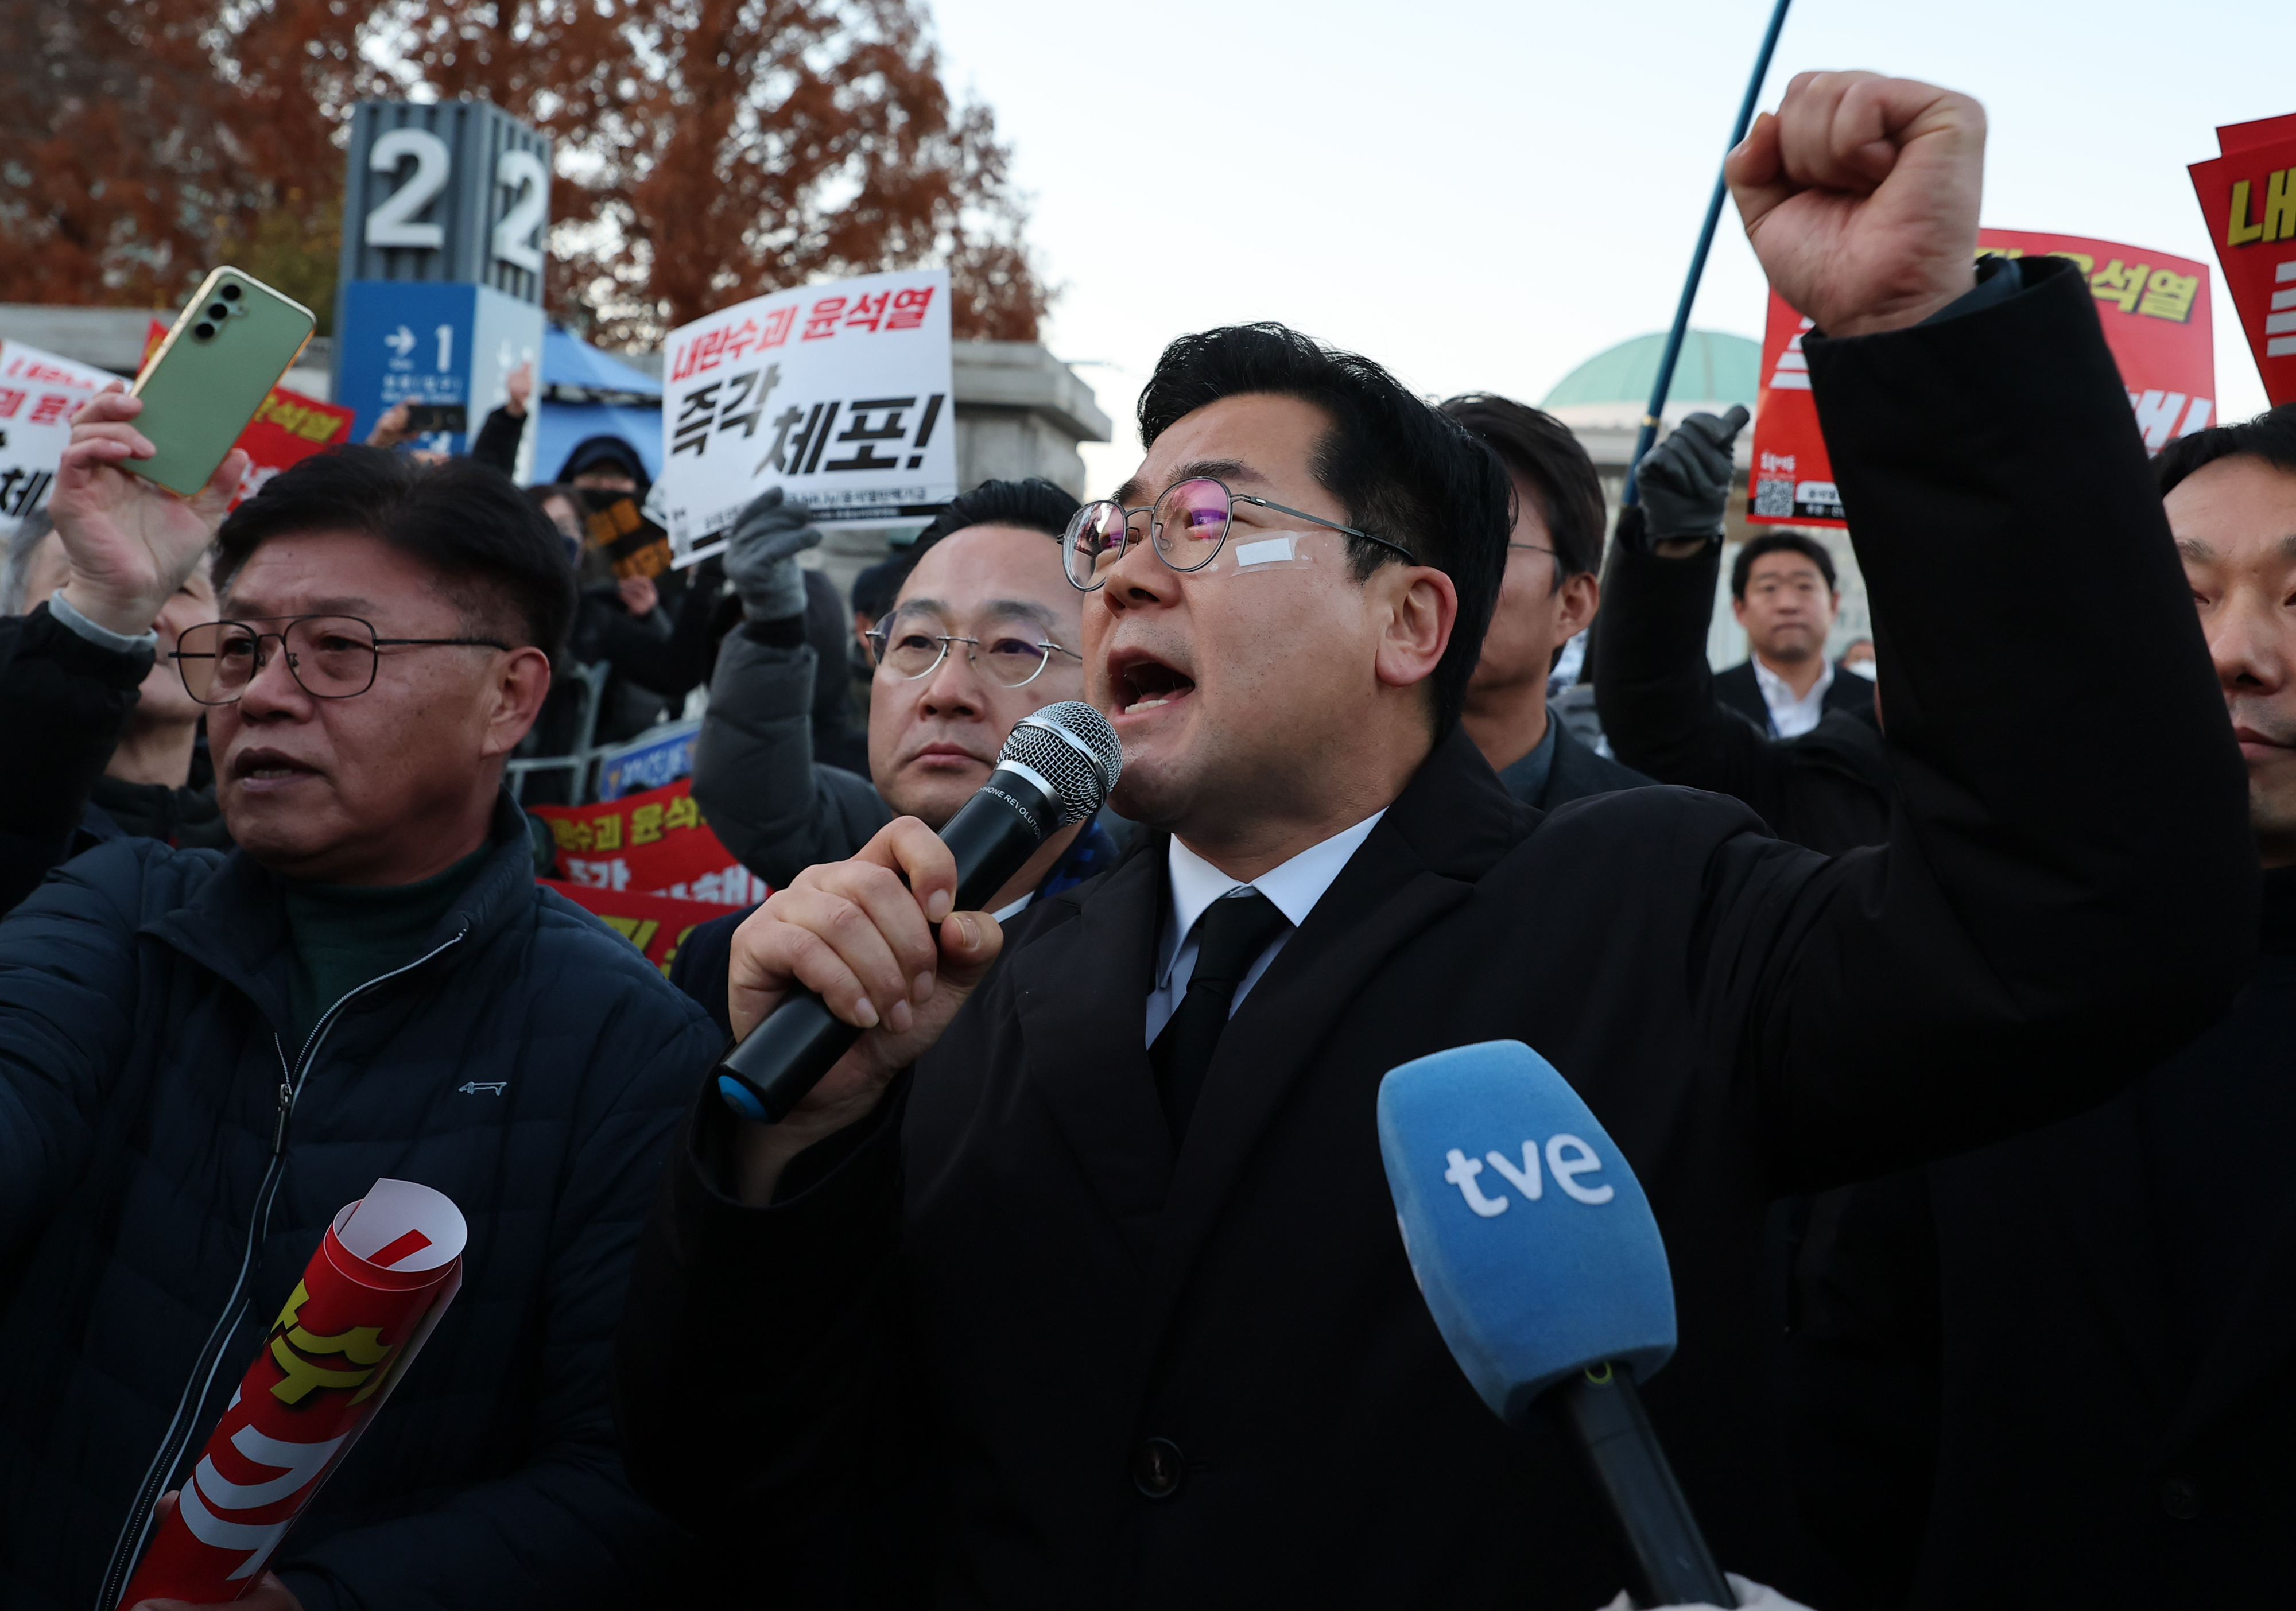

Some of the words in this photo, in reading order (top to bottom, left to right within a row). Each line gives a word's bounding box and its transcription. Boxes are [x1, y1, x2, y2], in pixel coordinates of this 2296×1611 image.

[366, 127, 450, 247] 2
[494, 149, 546, 273] 2
[435, 323, 453, 374] 1
[670, 305, 800, 383] 내란수괴
[800, 285, 935, 342] 윤석열
[673, 363, 782, 457] 즉각
[751, 393, 945, 476] 체포!
[631, 795, 707, 845] 윤석
[1004, 794, 1042, 839] REVOLUTION
[1445, 1133, 1614, 1217] tve
